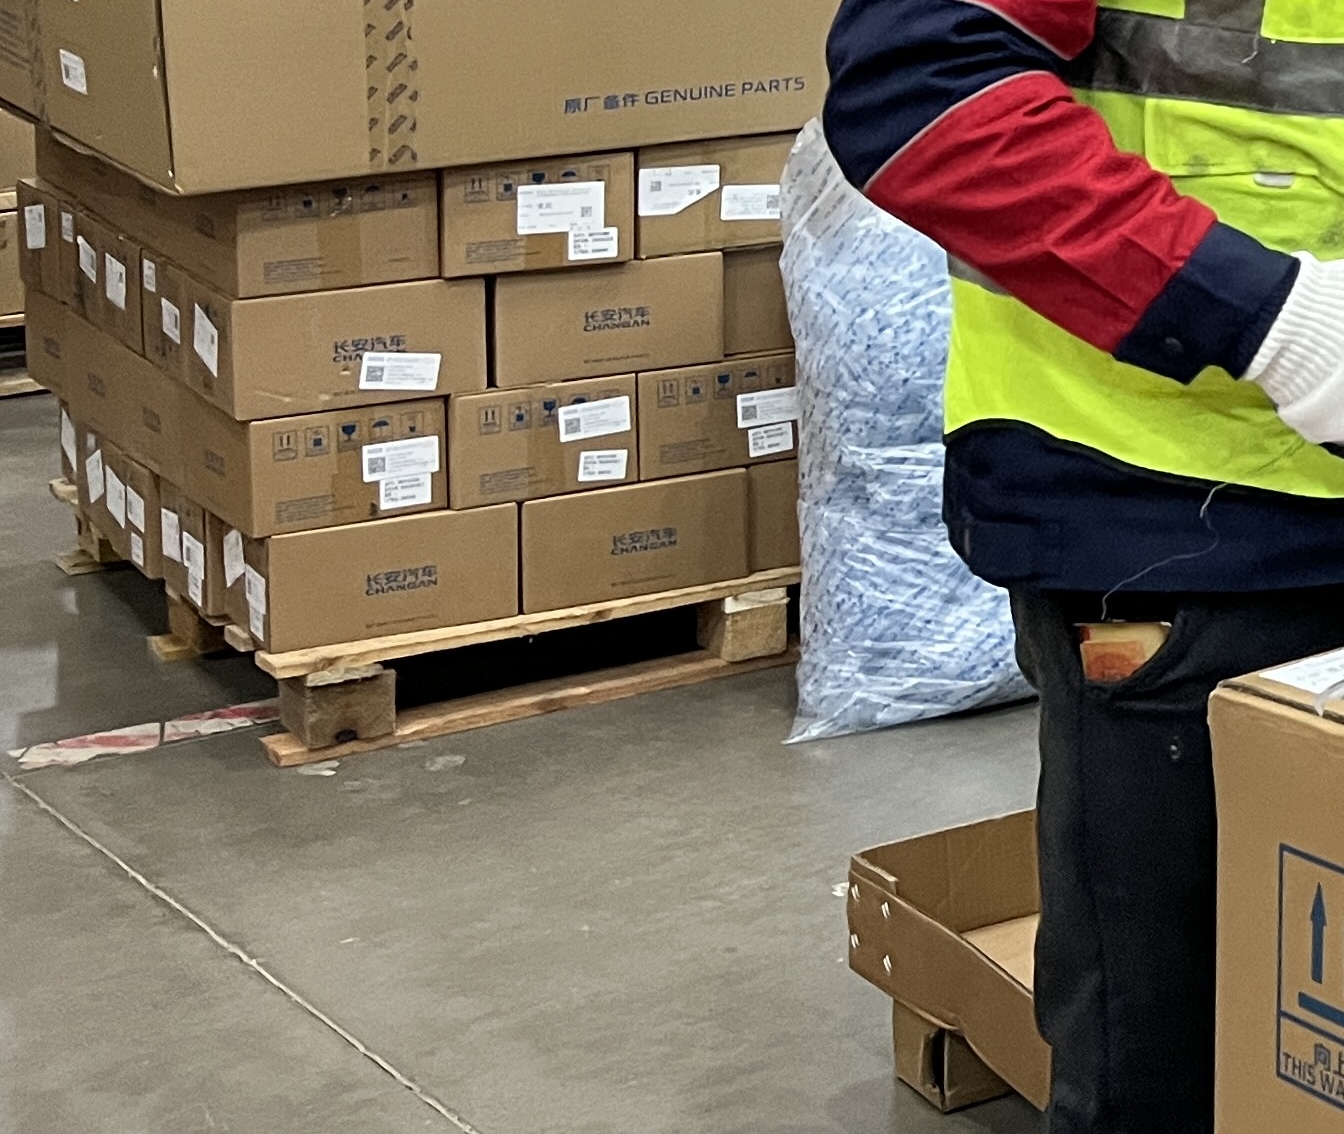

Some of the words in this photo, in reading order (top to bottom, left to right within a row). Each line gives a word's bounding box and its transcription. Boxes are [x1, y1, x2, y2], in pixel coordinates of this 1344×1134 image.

[644, 83, 737, 106] GENUINE
[741, 76, 806, 96] PARTS
[1282, 1051, 1317, 1087] THIS
